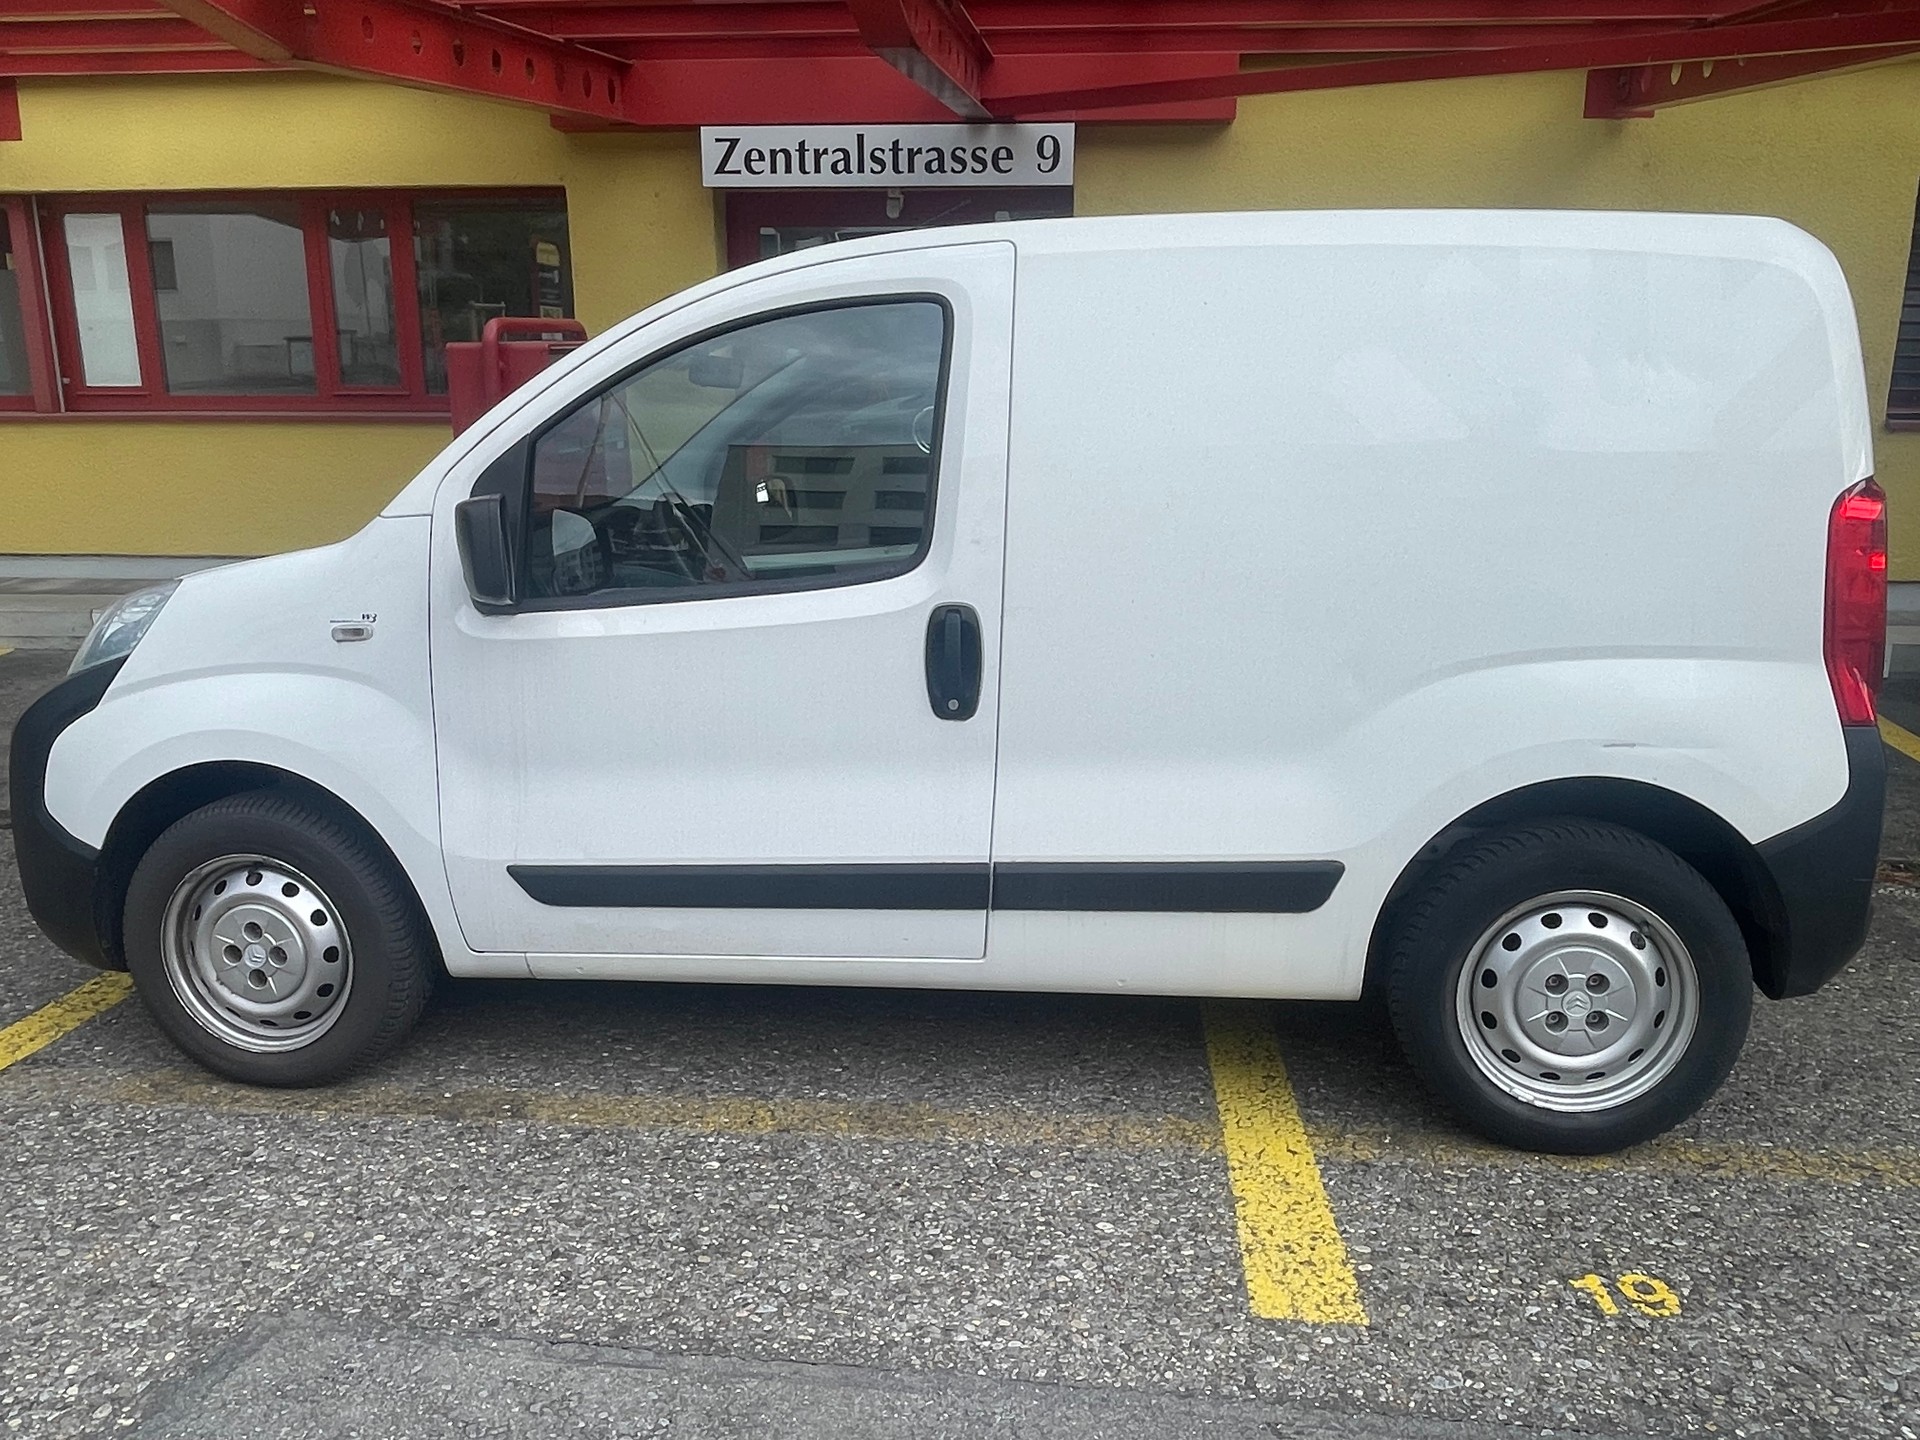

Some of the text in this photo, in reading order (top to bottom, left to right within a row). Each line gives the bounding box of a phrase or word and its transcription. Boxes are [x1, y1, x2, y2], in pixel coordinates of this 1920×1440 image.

[714, 133, 1061, 175] Zentralstrasse 9
[1568, 1273, 1682, 1317] 19
